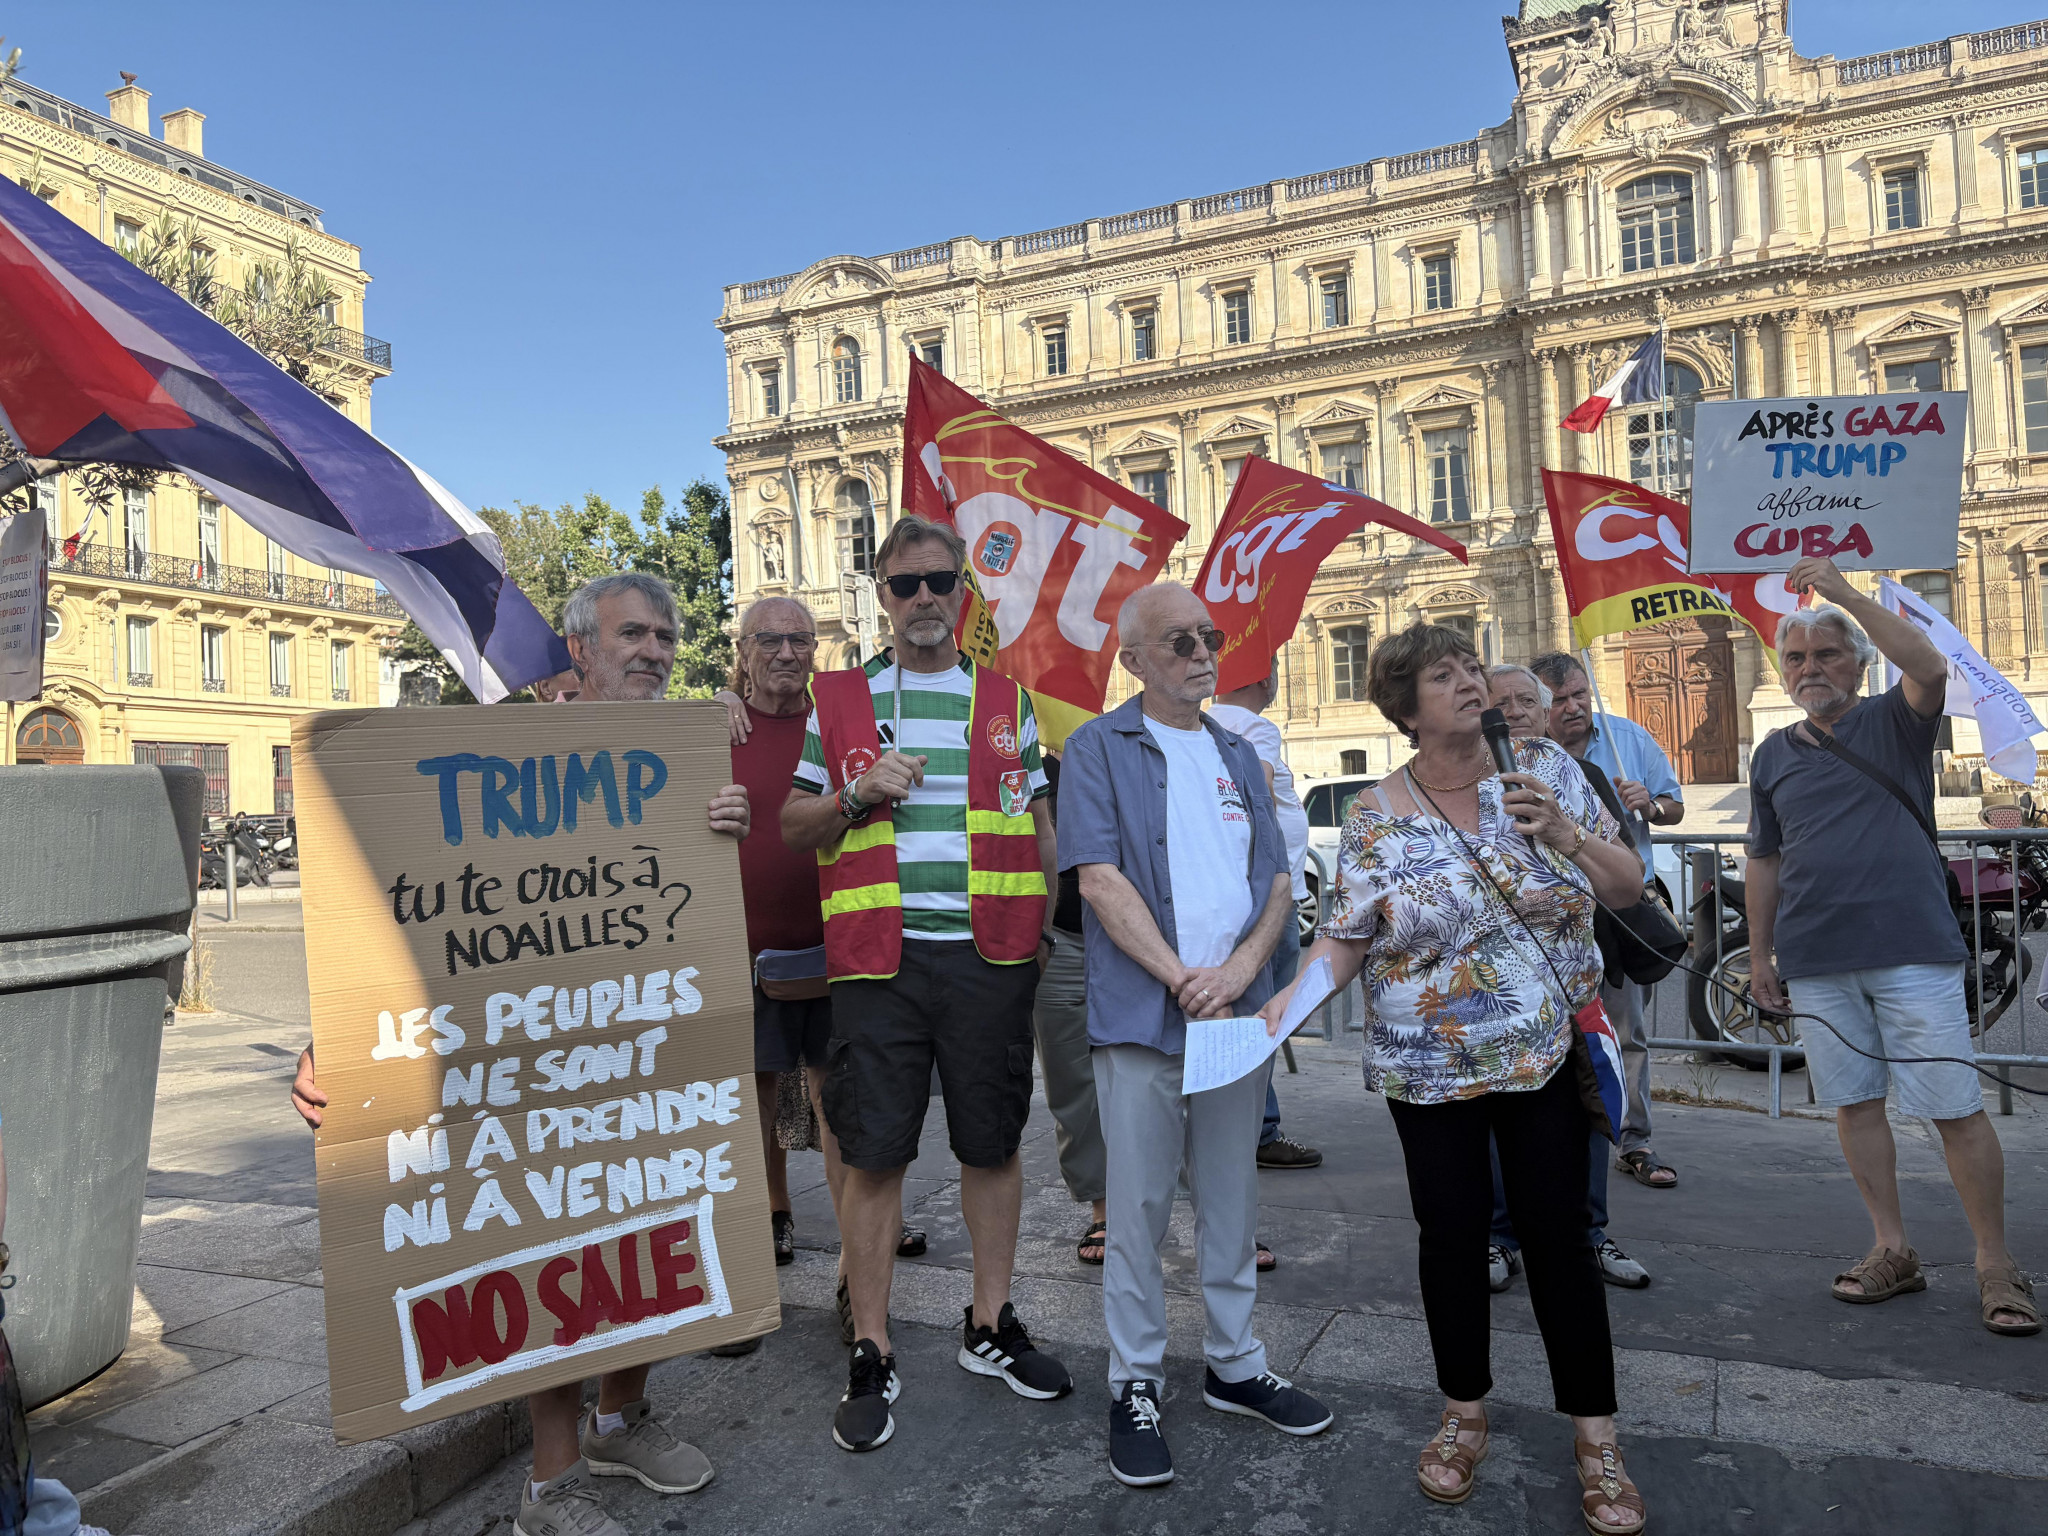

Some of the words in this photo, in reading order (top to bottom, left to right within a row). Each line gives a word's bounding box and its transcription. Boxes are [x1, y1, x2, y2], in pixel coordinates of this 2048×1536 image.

[1738, 403, 1834, 441] APRÈS
[1844, 402, 1945, 436] GAZA
[1765, 441, 1907, 478] TRUMP
[1734, 523, 1873, 558] CUBA
[1757, 486, 1883, 520] affame
[1204, 502, 1347, 604] cgt
[416, 750, 668, 846] TRUMP
[1216, 778, 1237, 791] STO
[388, 873, 445, 924] tu
[456, 863, 503, 915] te
[517, 855, 625, 904] crois
[371, 1004, 466, 1060] LES
[485, 966, 702, 1045] PEUPLES
[442, 1056, 521, 1107] NE
[529, 1025, 667, 1092] SONT
[527, 1077, 741, 1153] PRENDRE
[524, 1141, 737, 1219] VENDRE
[413, 1268, 529, 1380] NO
[537, 1221, 704, 1345] SALE
